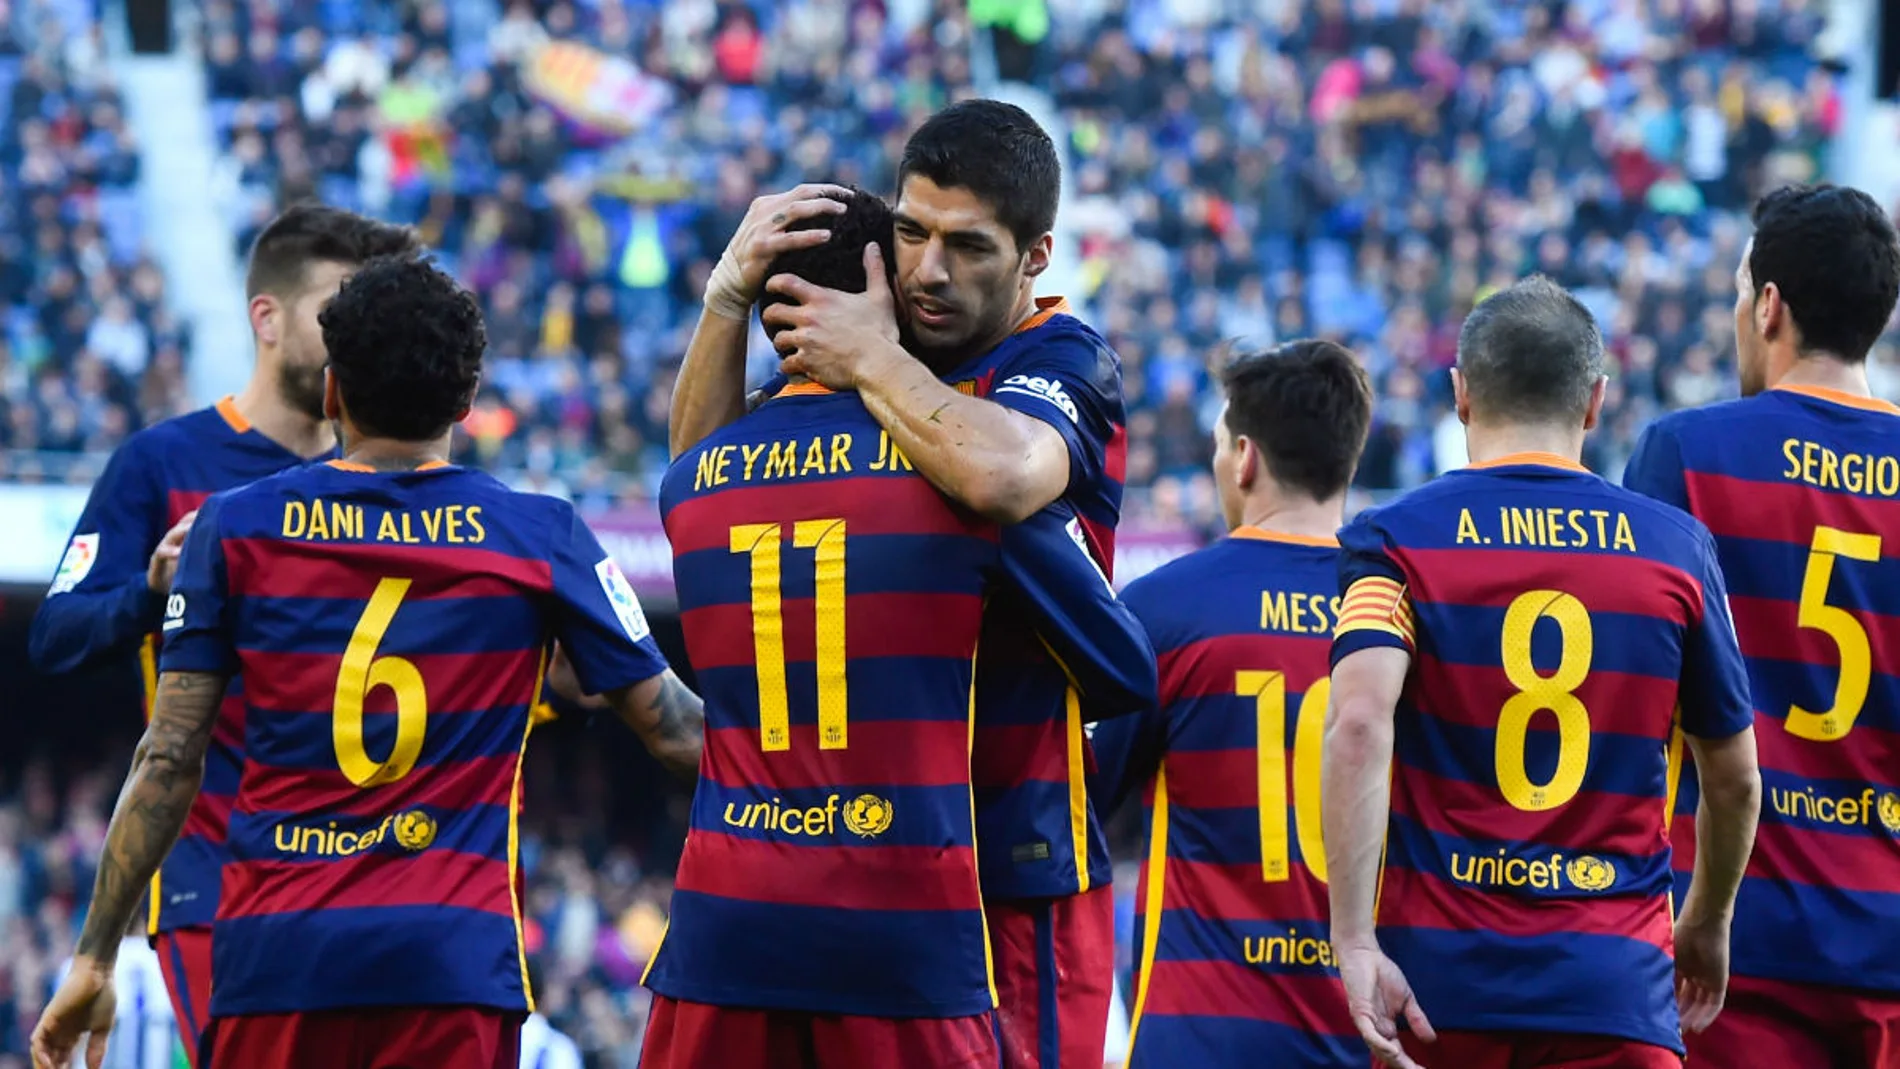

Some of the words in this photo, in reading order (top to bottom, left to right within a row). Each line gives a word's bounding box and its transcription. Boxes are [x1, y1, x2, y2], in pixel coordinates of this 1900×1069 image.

[694, 433, 853, 492] NEYMAR
[1783, 438, 1900, 496] SERGIO
[282, 498, 364, 541] DANI
[378, 505, 486, 544] ALVES
[1457, 509, 1492, 544] A.
[1501, 507, 1637, 552] INIESTA
[729, 518, 848, 752] 11
[1784, 525, 1883, 741] 5
[332, 577, 428, 788] 6
[1494, 589, 1594, 812] 8
[724, 793, 840, 837] unicef
[1772, 787, 1875, 827] unicef
[274, 812, 393, 857] unicef
[1450, 848, 1563, 890] unicef
[1243, 927, 1340, 968] unice
